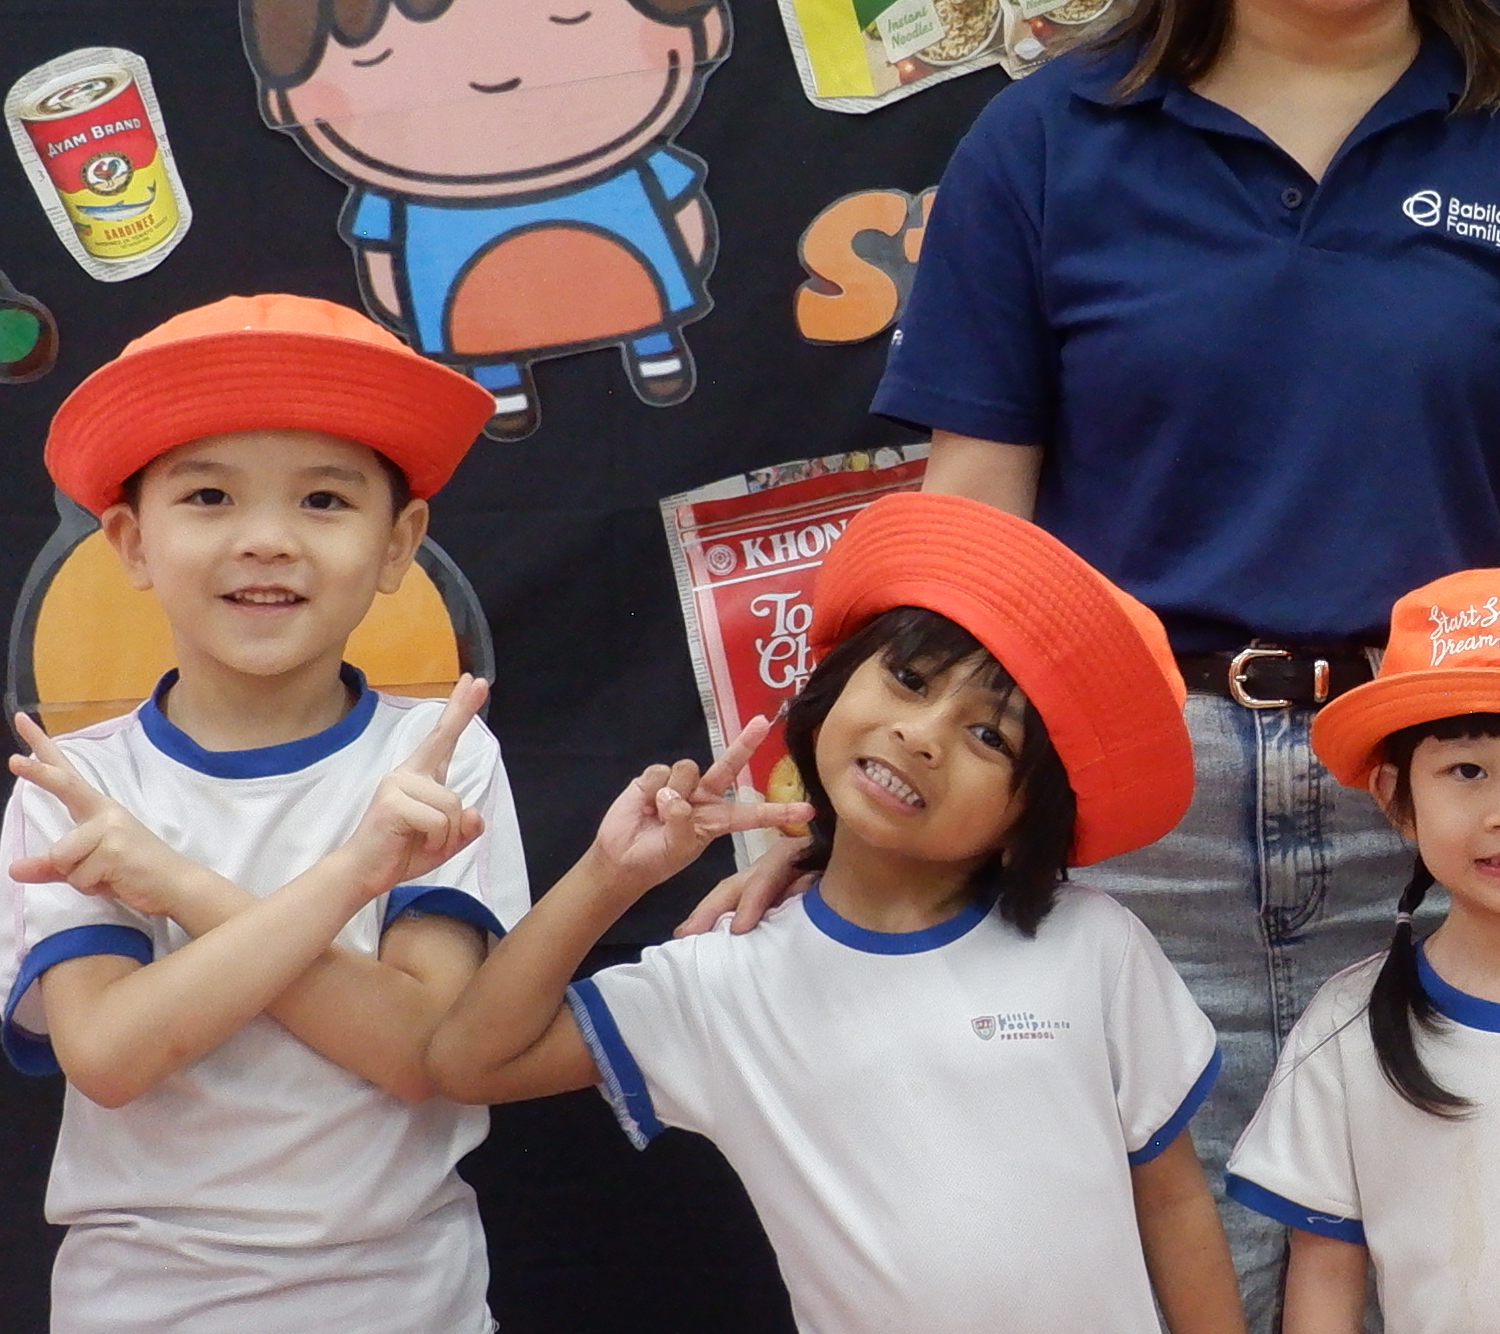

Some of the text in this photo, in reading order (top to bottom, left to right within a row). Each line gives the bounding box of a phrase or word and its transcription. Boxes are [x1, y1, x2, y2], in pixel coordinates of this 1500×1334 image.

[886, 5, 929, 34] Instant
[889, 19, 936, 50] Noodles
[46, 117, 143, 160] AYAM BRAND
[103, 213, 156, 242] SARDINES
[1428, 604, 1482, 641] Start
[1430, 630, 1500, 667] Dream
